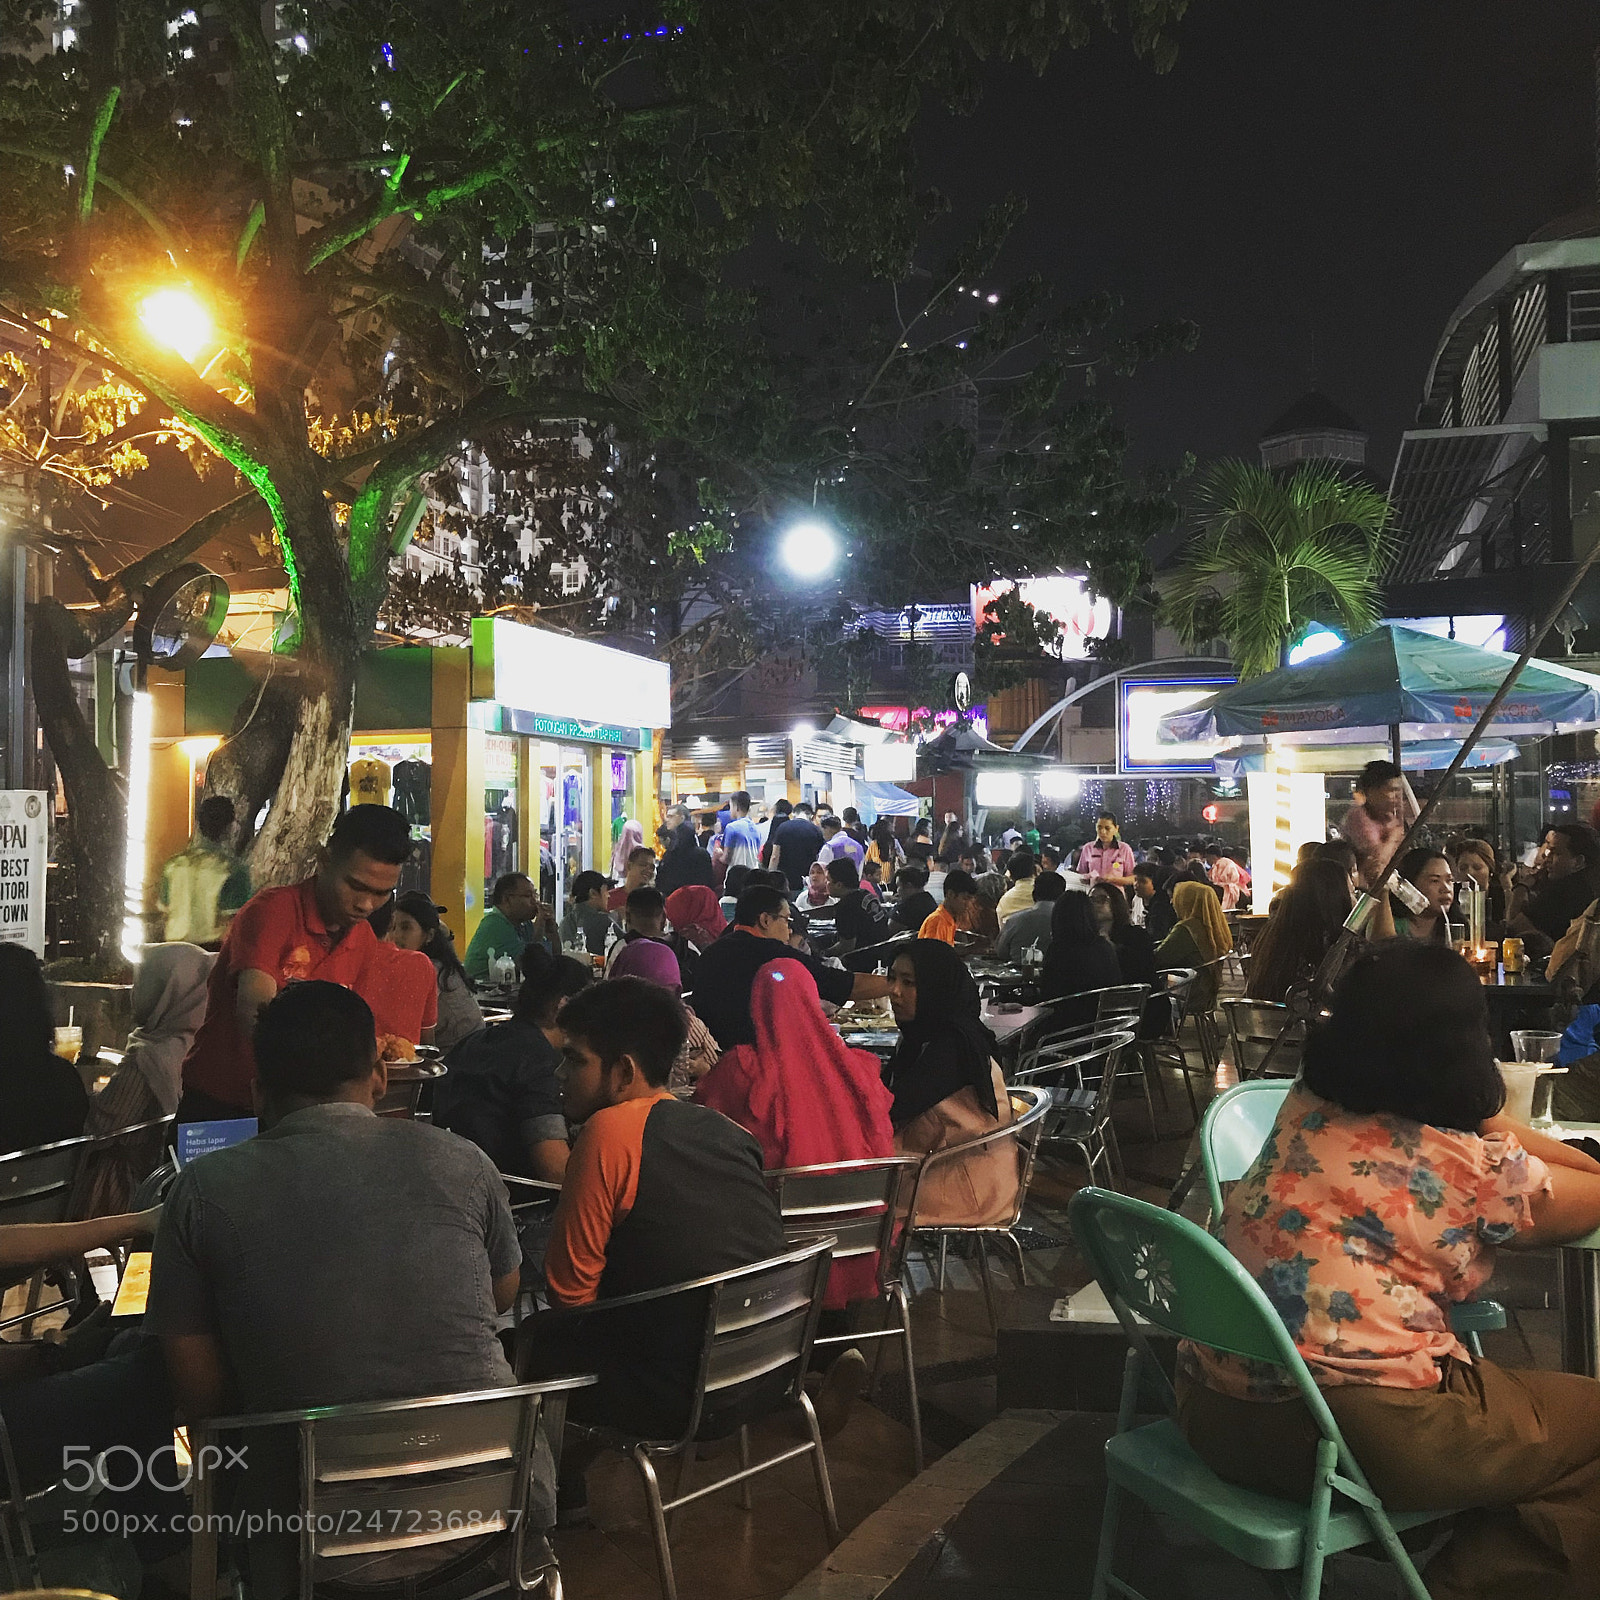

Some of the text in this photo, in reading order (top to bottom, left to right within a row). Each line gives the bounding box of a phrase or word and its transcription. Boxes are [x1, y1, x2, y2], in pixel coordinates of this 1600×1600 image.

[1282, 707, 1346, 724] MAYORA
[1, 858, 30, 878] BEST
[208, 1137, 226, 1145] lapar
